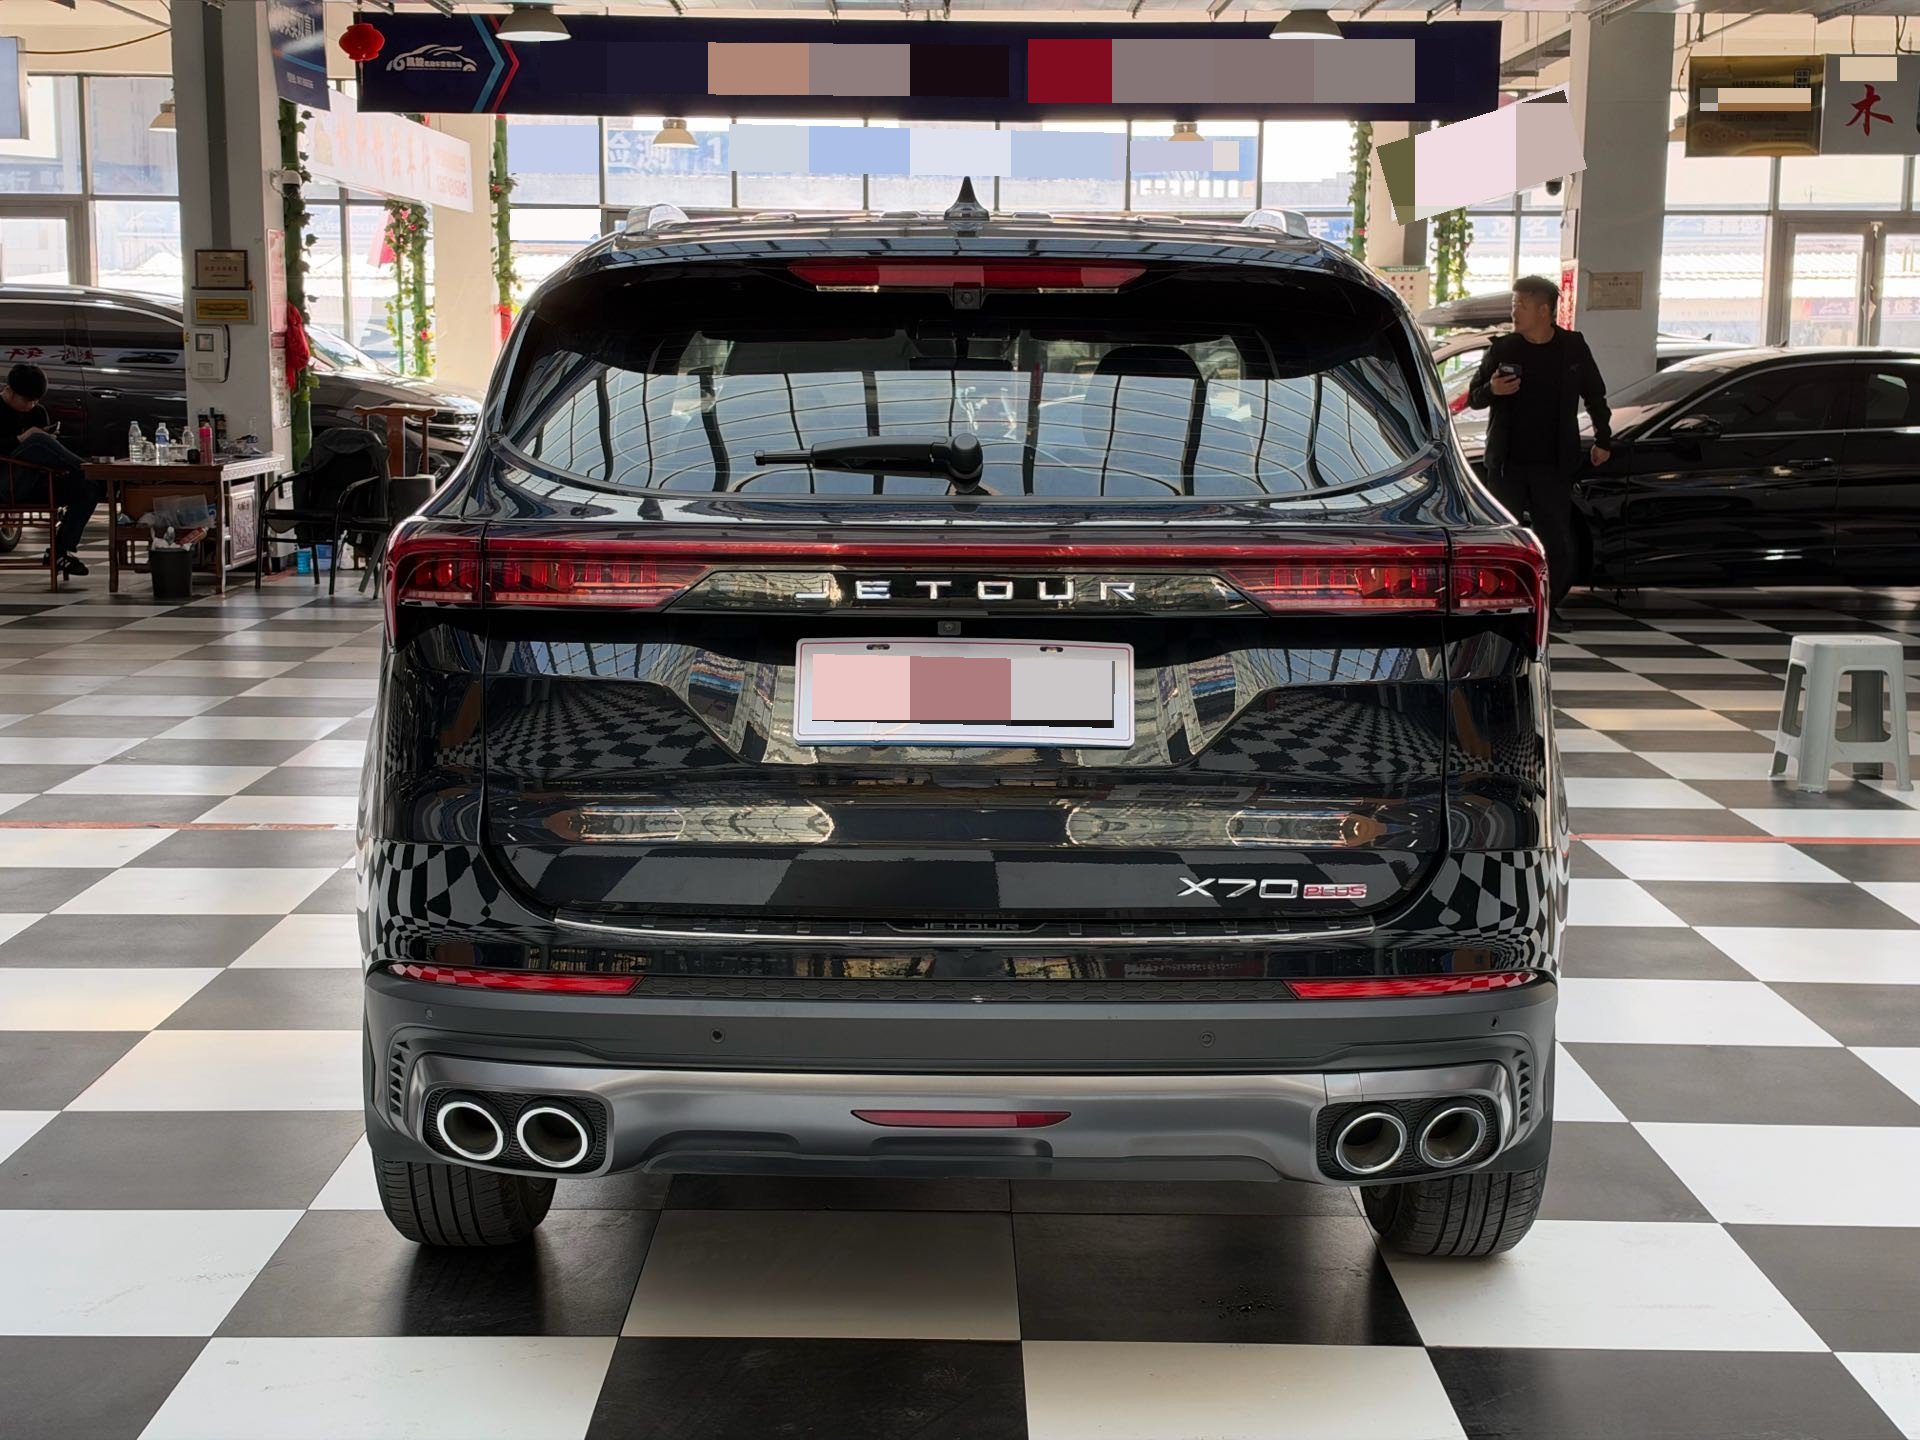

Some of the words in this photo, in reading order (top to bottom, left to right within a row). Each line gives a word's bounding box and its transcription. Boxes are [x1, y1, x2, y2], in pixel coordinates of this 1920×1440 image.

[1845, 83, 1894, 136] 木
[794, 579, 1137, 601] JETOUR
[1177, 876, 1300, 899] X70
[1303, 883, 1367, 899] PLUS
[911, 922, 1020, 931] JETOUR
